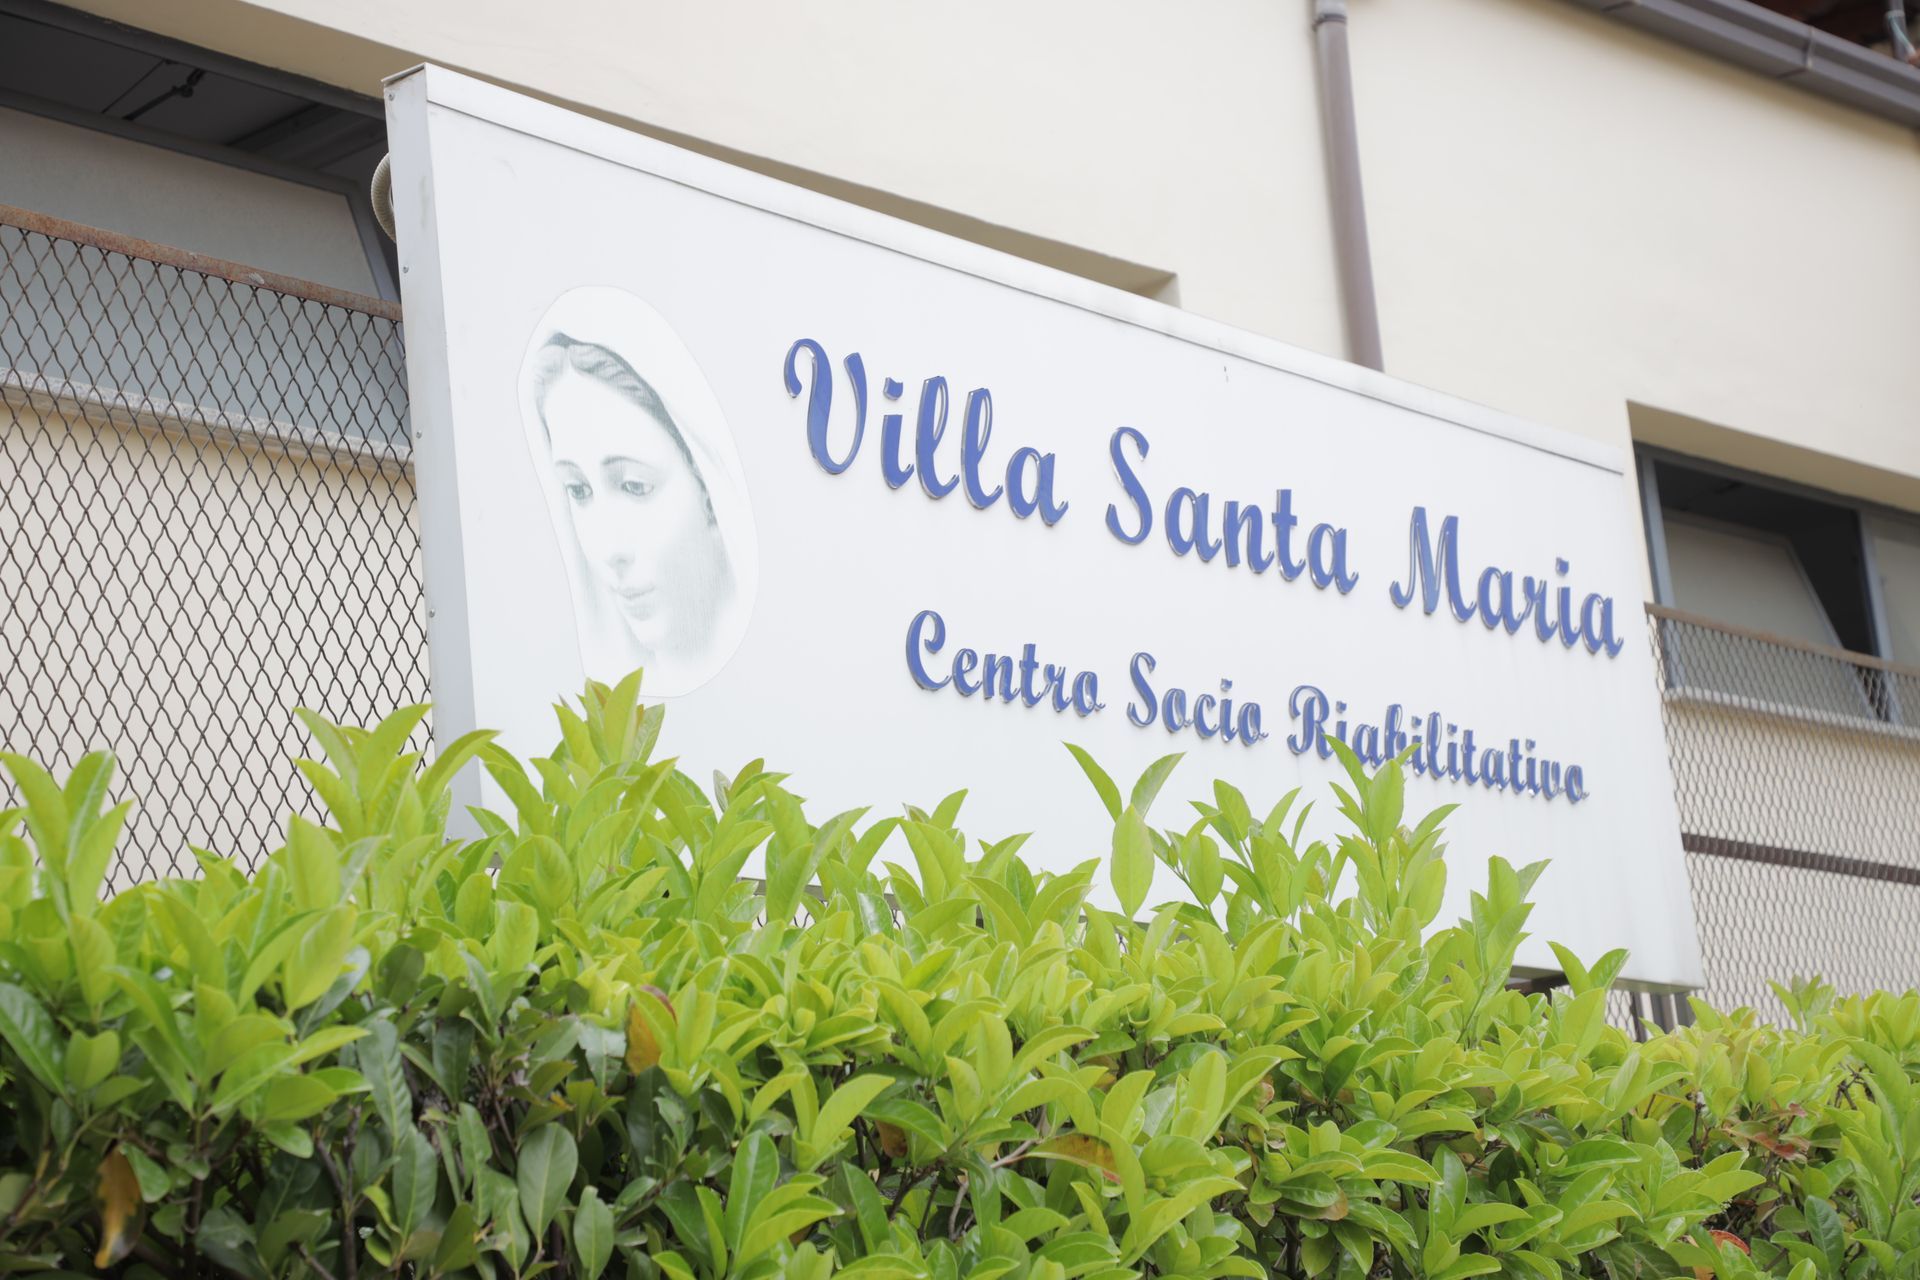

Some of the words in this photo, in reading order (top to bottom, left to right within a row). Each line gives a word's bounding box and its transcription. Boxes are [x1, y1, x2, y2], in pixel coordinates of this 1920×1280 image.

[784, 337, 1069, 526] Villa
[1105, 426, 1359, 595] Santa
[1390, 506, 1624, 658] Maria
[906, 610, 1105, 717] Centro
[1127, 652, 1269, 746] Socio
[1287, 685, 1590, 804] Riabilitativo
